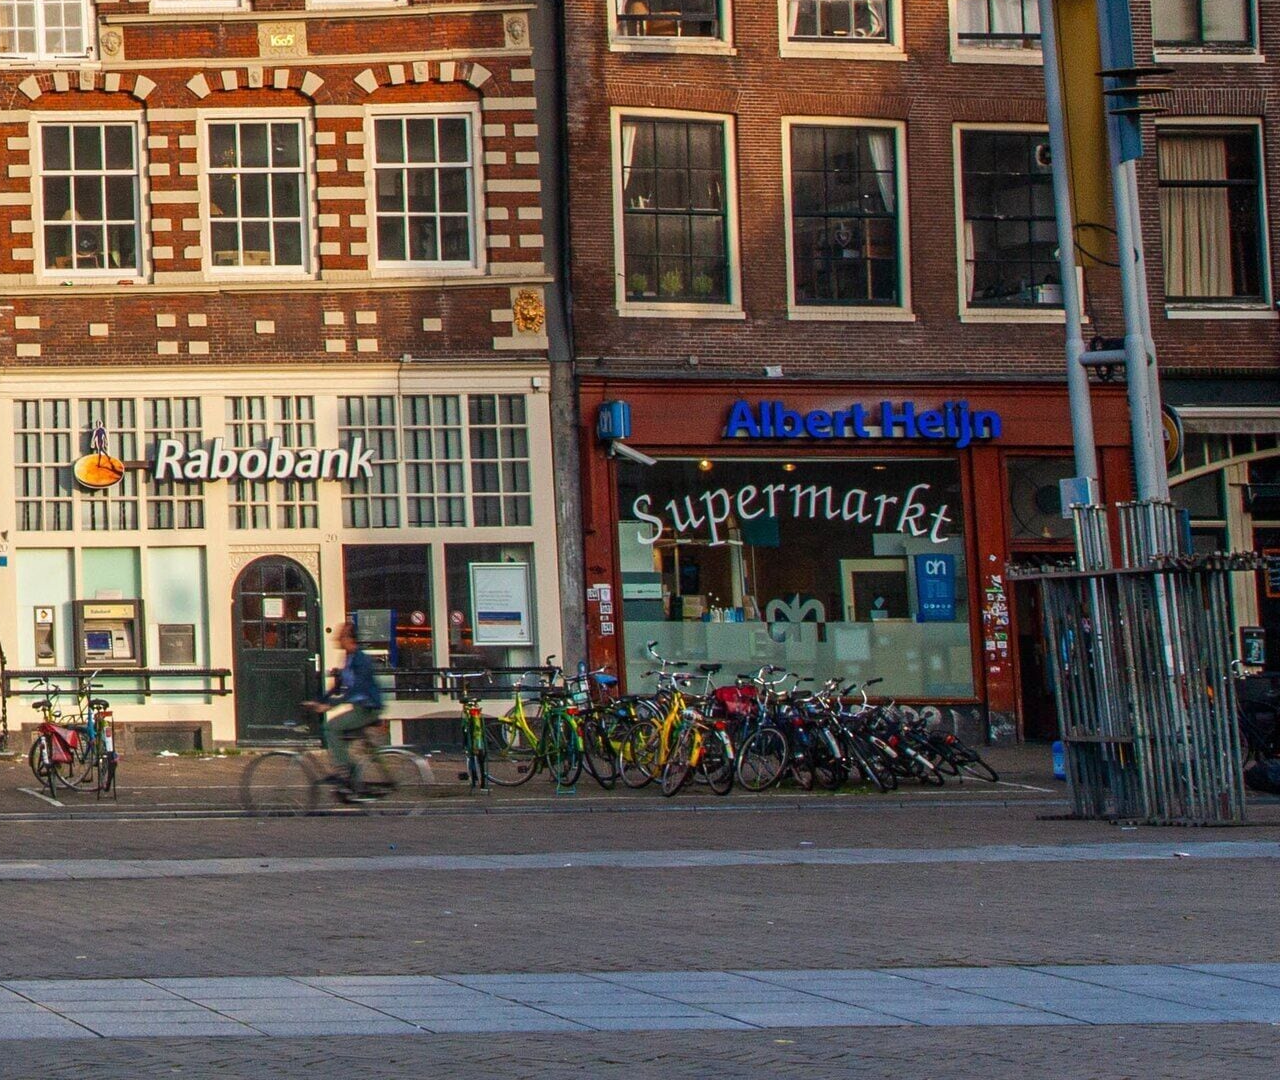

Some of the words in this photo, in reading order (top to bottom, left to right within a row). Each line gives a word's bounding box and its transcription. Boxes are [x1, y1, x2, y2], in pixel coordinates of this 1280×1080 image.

[725, 399, 871, 439] Albert
[881, 399, 1003, 449] Heijn
[154, 436, 376, 480] Rabobank
[632, 483, 952, 547] Supermarkt
